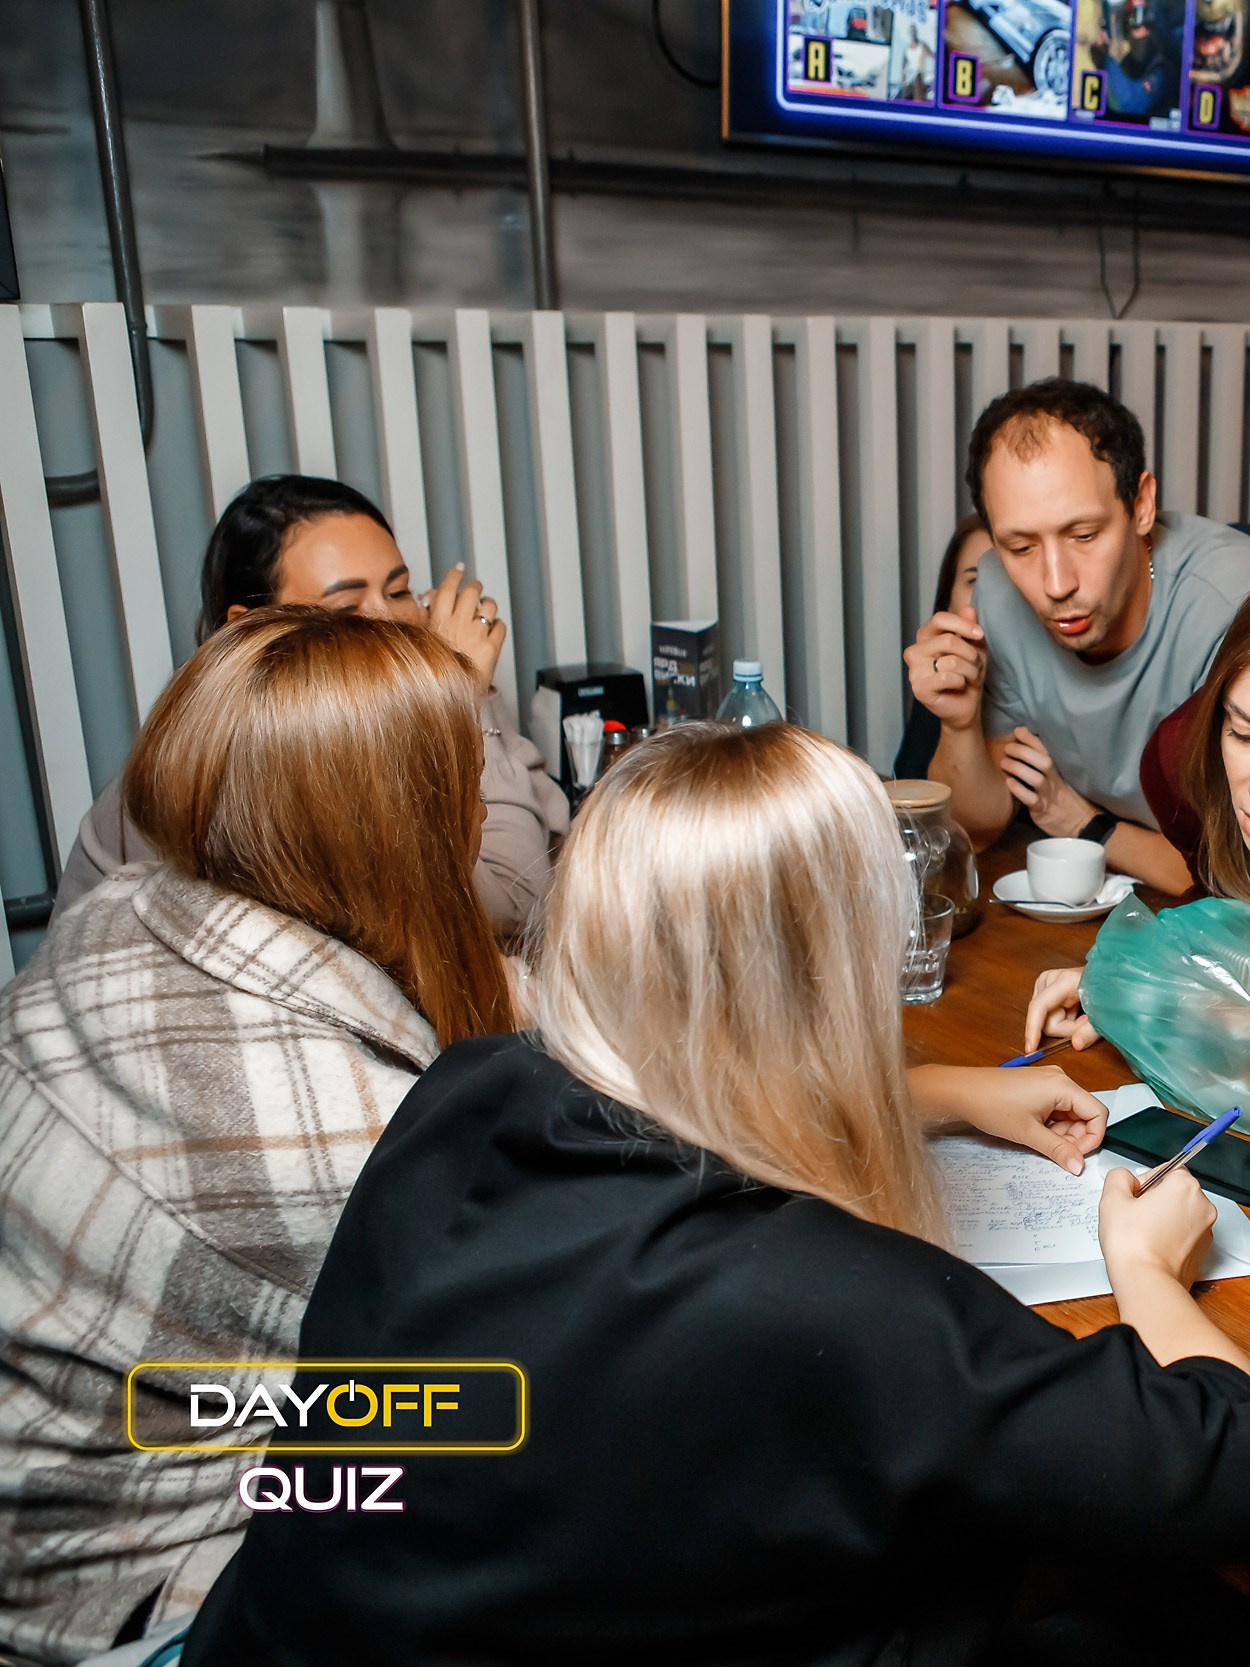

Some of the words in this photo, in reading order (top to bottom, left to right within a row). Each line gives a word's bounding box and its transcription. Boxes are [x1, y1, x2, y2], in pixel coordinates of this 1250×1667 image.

[808, 40, 826, 81] A
[955, 58, 973, 97] B
[1084, 75, 1100, 111] C
